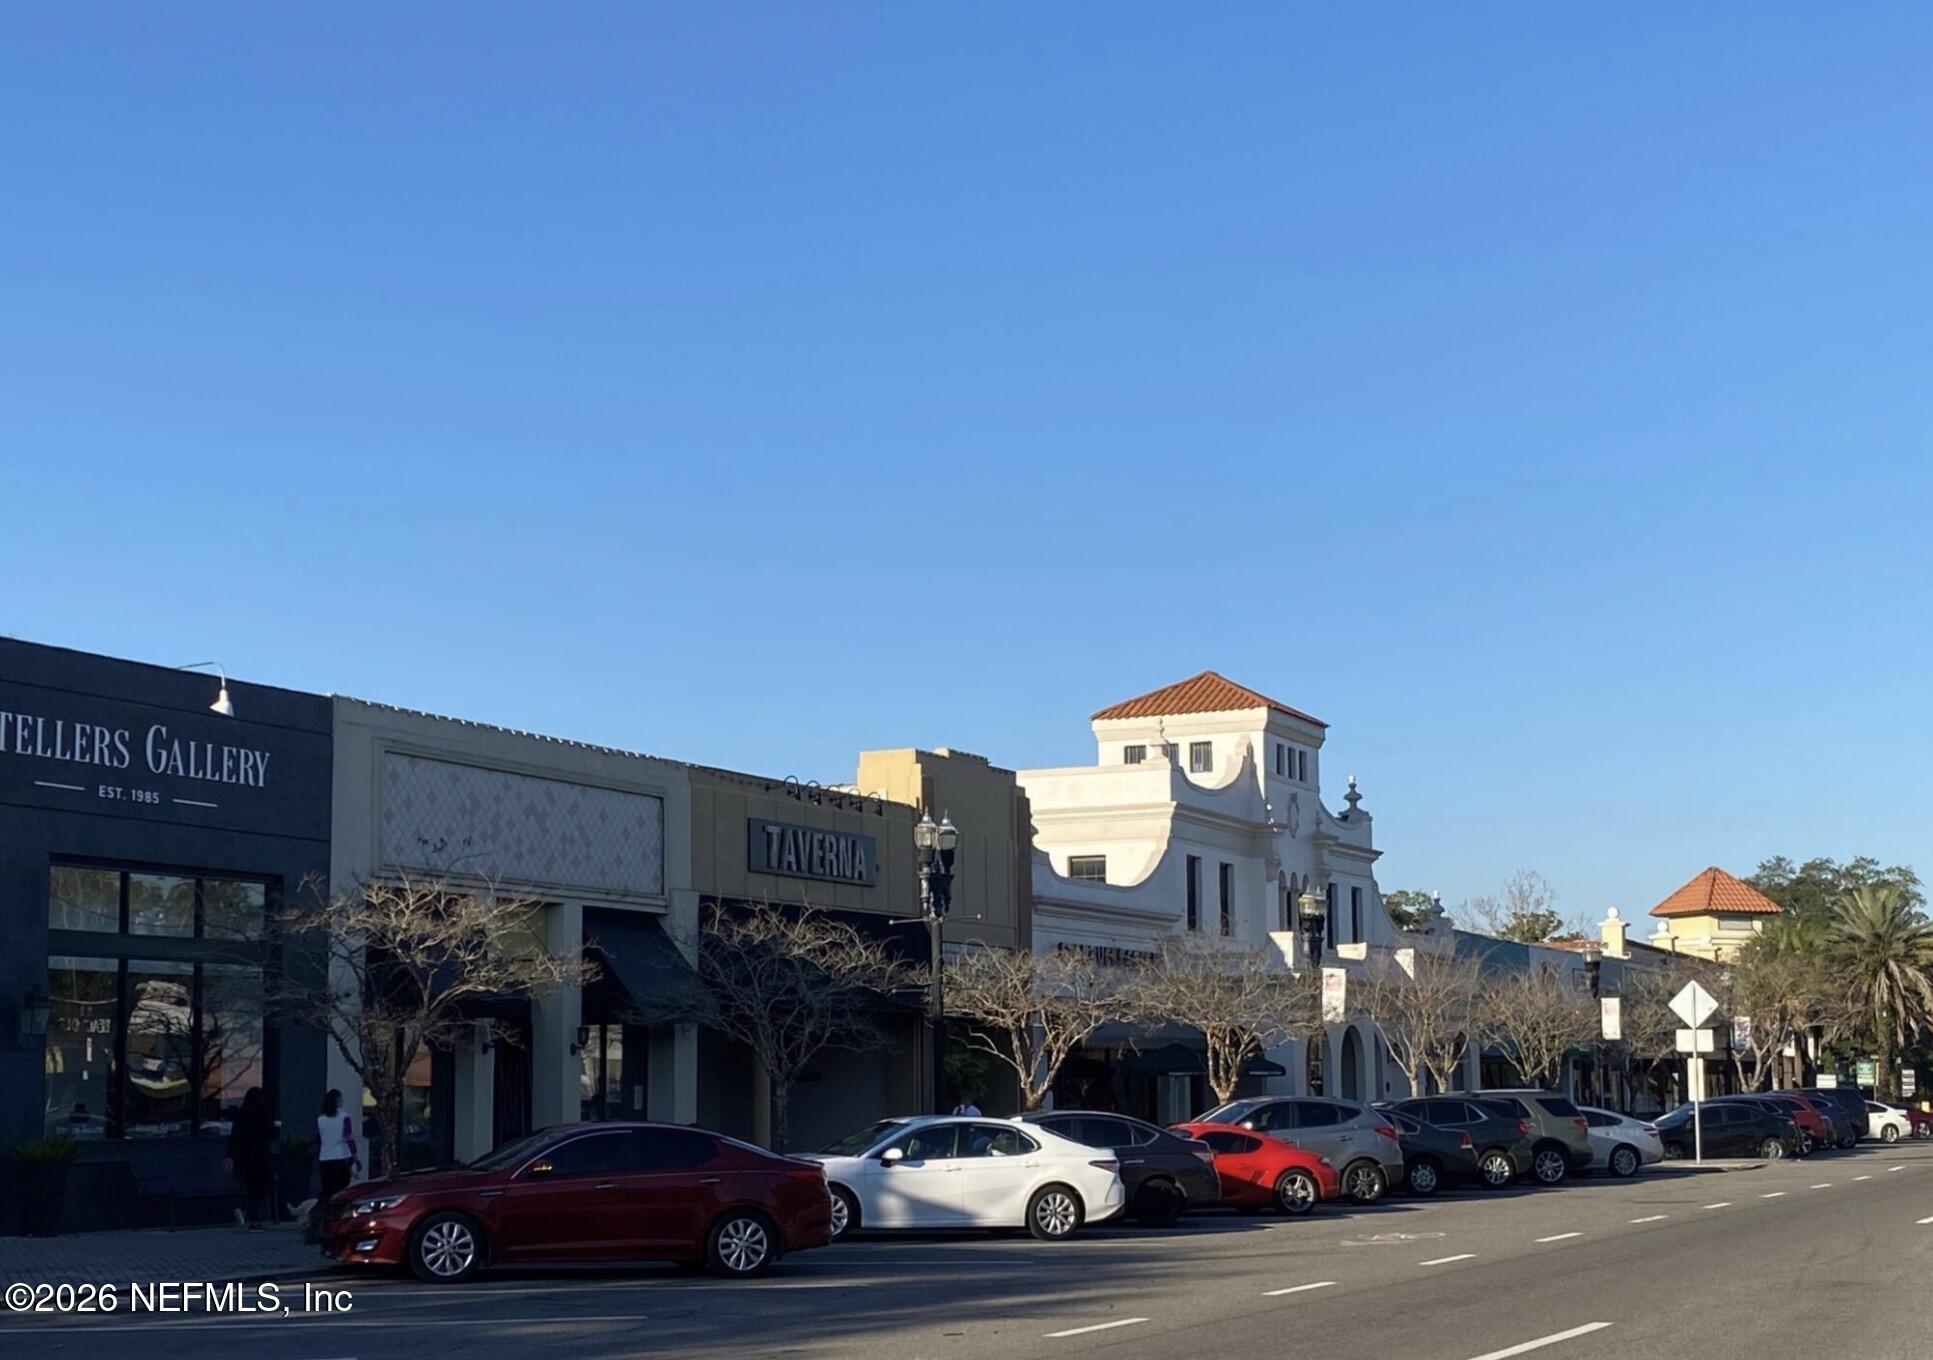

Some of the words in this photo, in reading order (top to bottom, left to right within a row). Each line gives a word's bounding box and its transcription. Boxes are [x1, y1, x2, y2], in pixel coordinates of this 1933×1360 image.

[145, 724, 271, 788] GALLERY
[98, 784, 127, 801] EST.
[131, 788, 160, 804] 1985
[764, 824, 868, 880] TAVERNA
